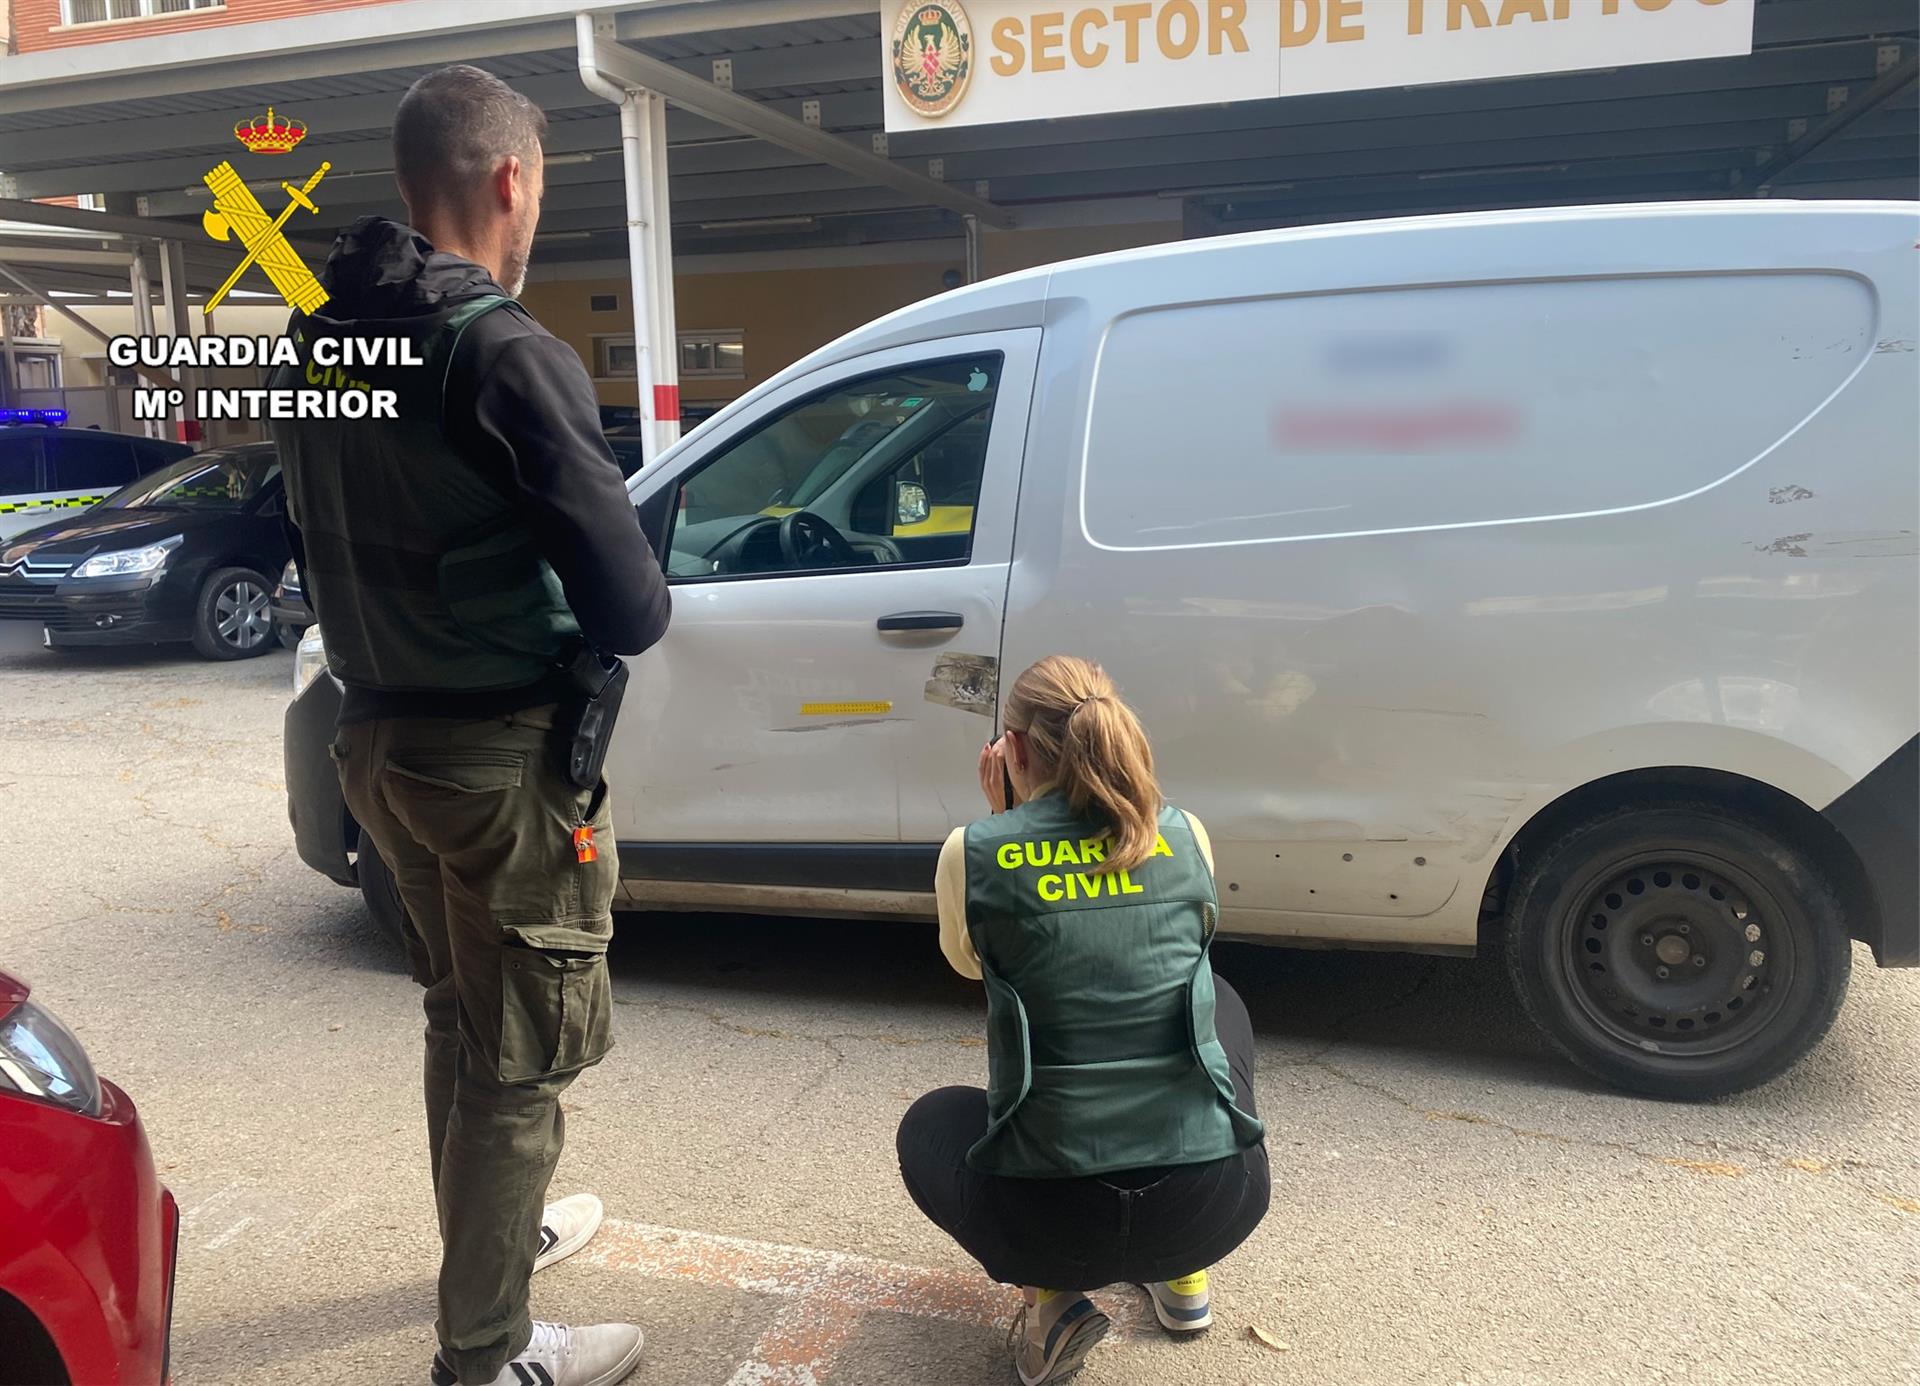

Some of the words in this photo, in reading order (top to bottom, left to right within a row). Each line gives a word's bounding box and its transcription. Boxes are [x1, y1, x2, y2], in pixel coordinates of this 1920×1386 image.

[989, 0, 1250, 77] SECTOR
[1279, 0, 1365, 48] DE
[996, 832, 1175, 870] GUARA
[1037, 868, 1145, 901] CIVIL
